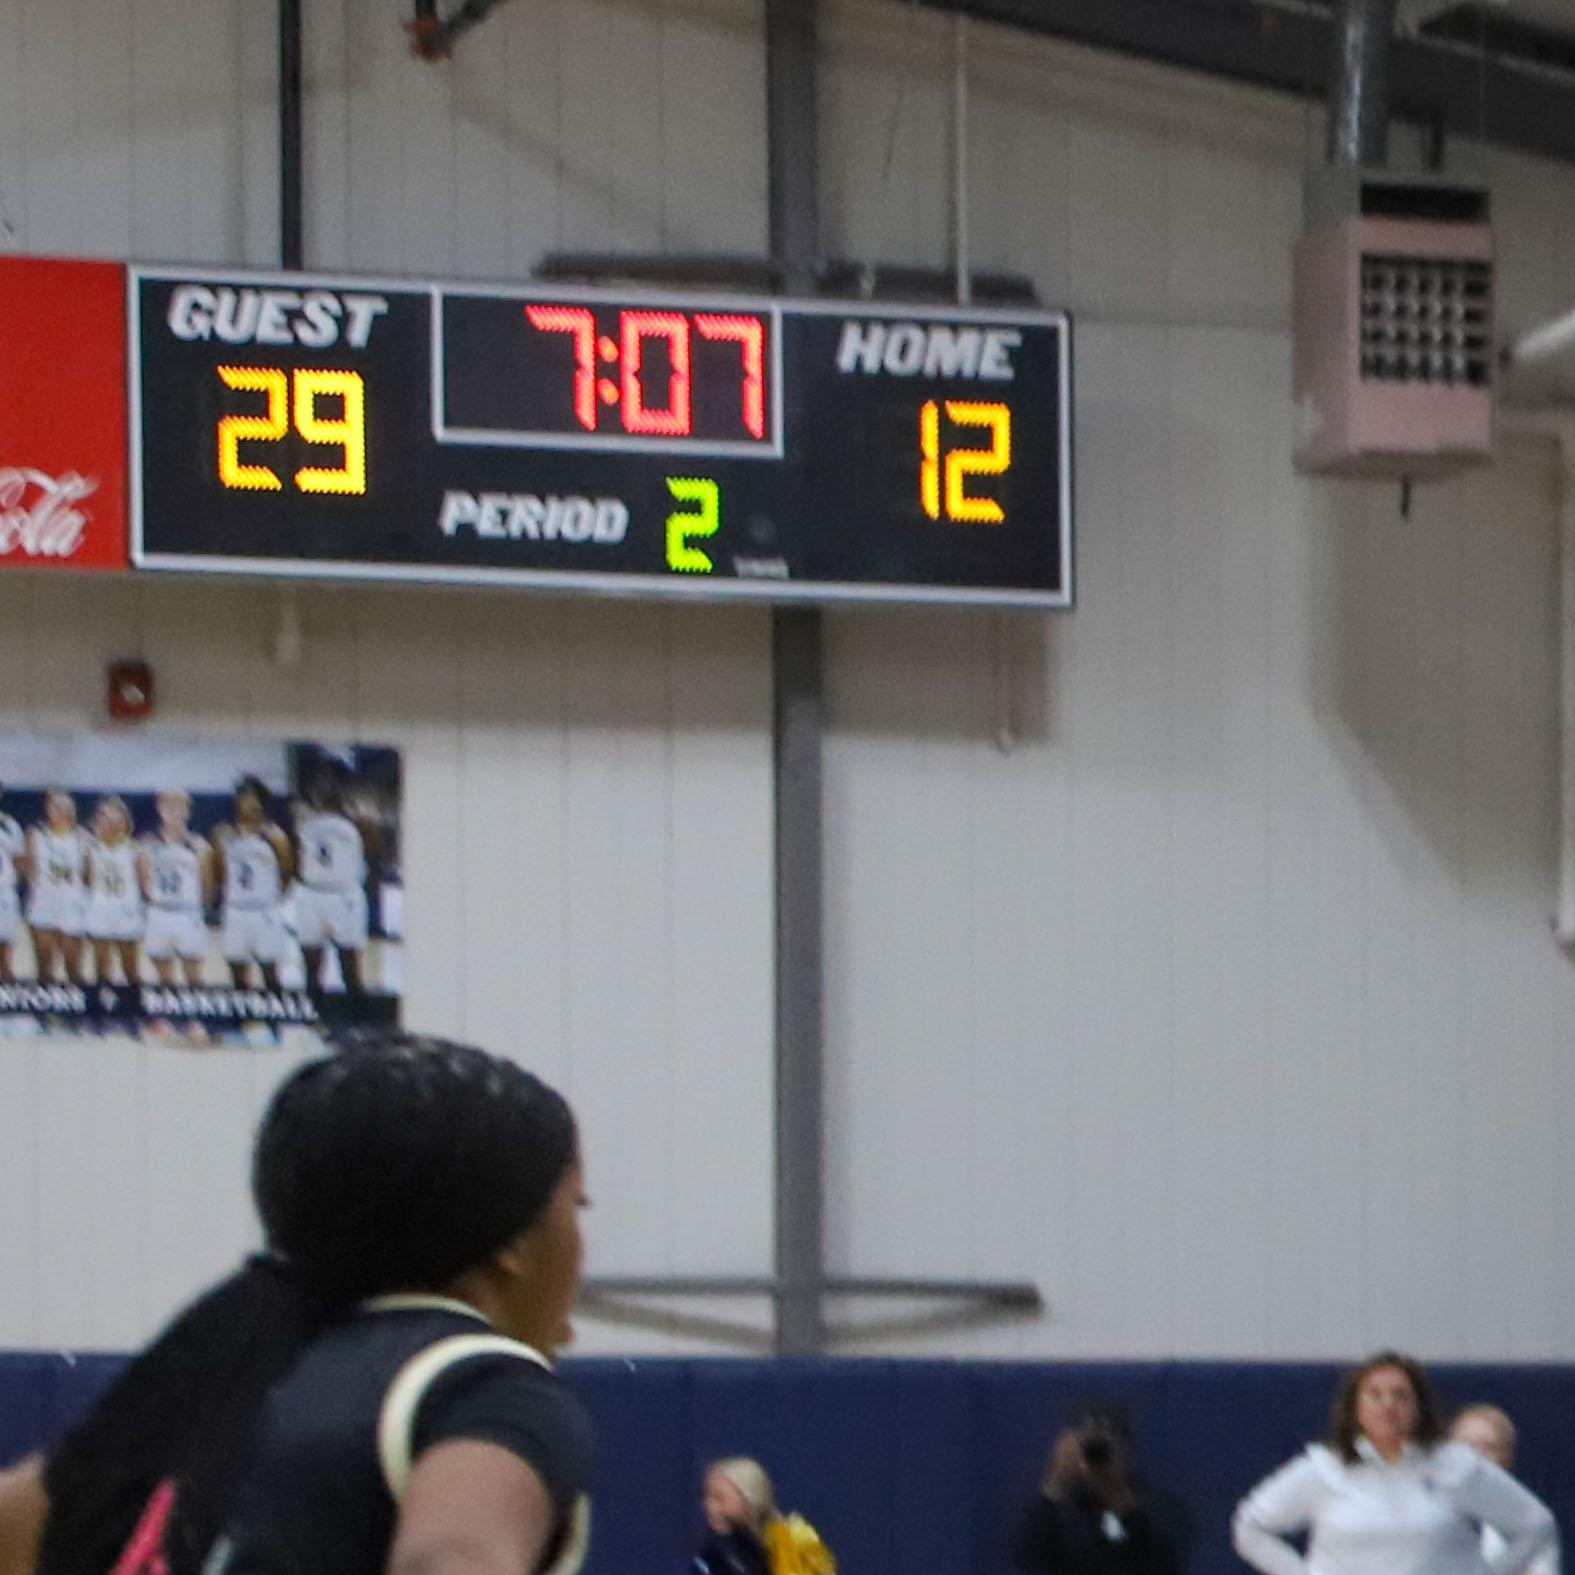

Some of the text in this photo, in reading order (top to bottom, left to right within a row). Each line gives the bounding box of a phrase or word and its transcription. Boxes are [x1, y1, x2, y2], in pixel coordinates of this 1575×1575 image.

[167, 285, 388, 348] GUEST
[836, 321, 1024, 381] HOME
[524, 304, 765, 439] 7:07
[216, 365, 367, 495] 29
[918, 399, 1012, 523] 12
[439, 489, 628, 543] PERIOD
[665, 476, 720, 572] 2
